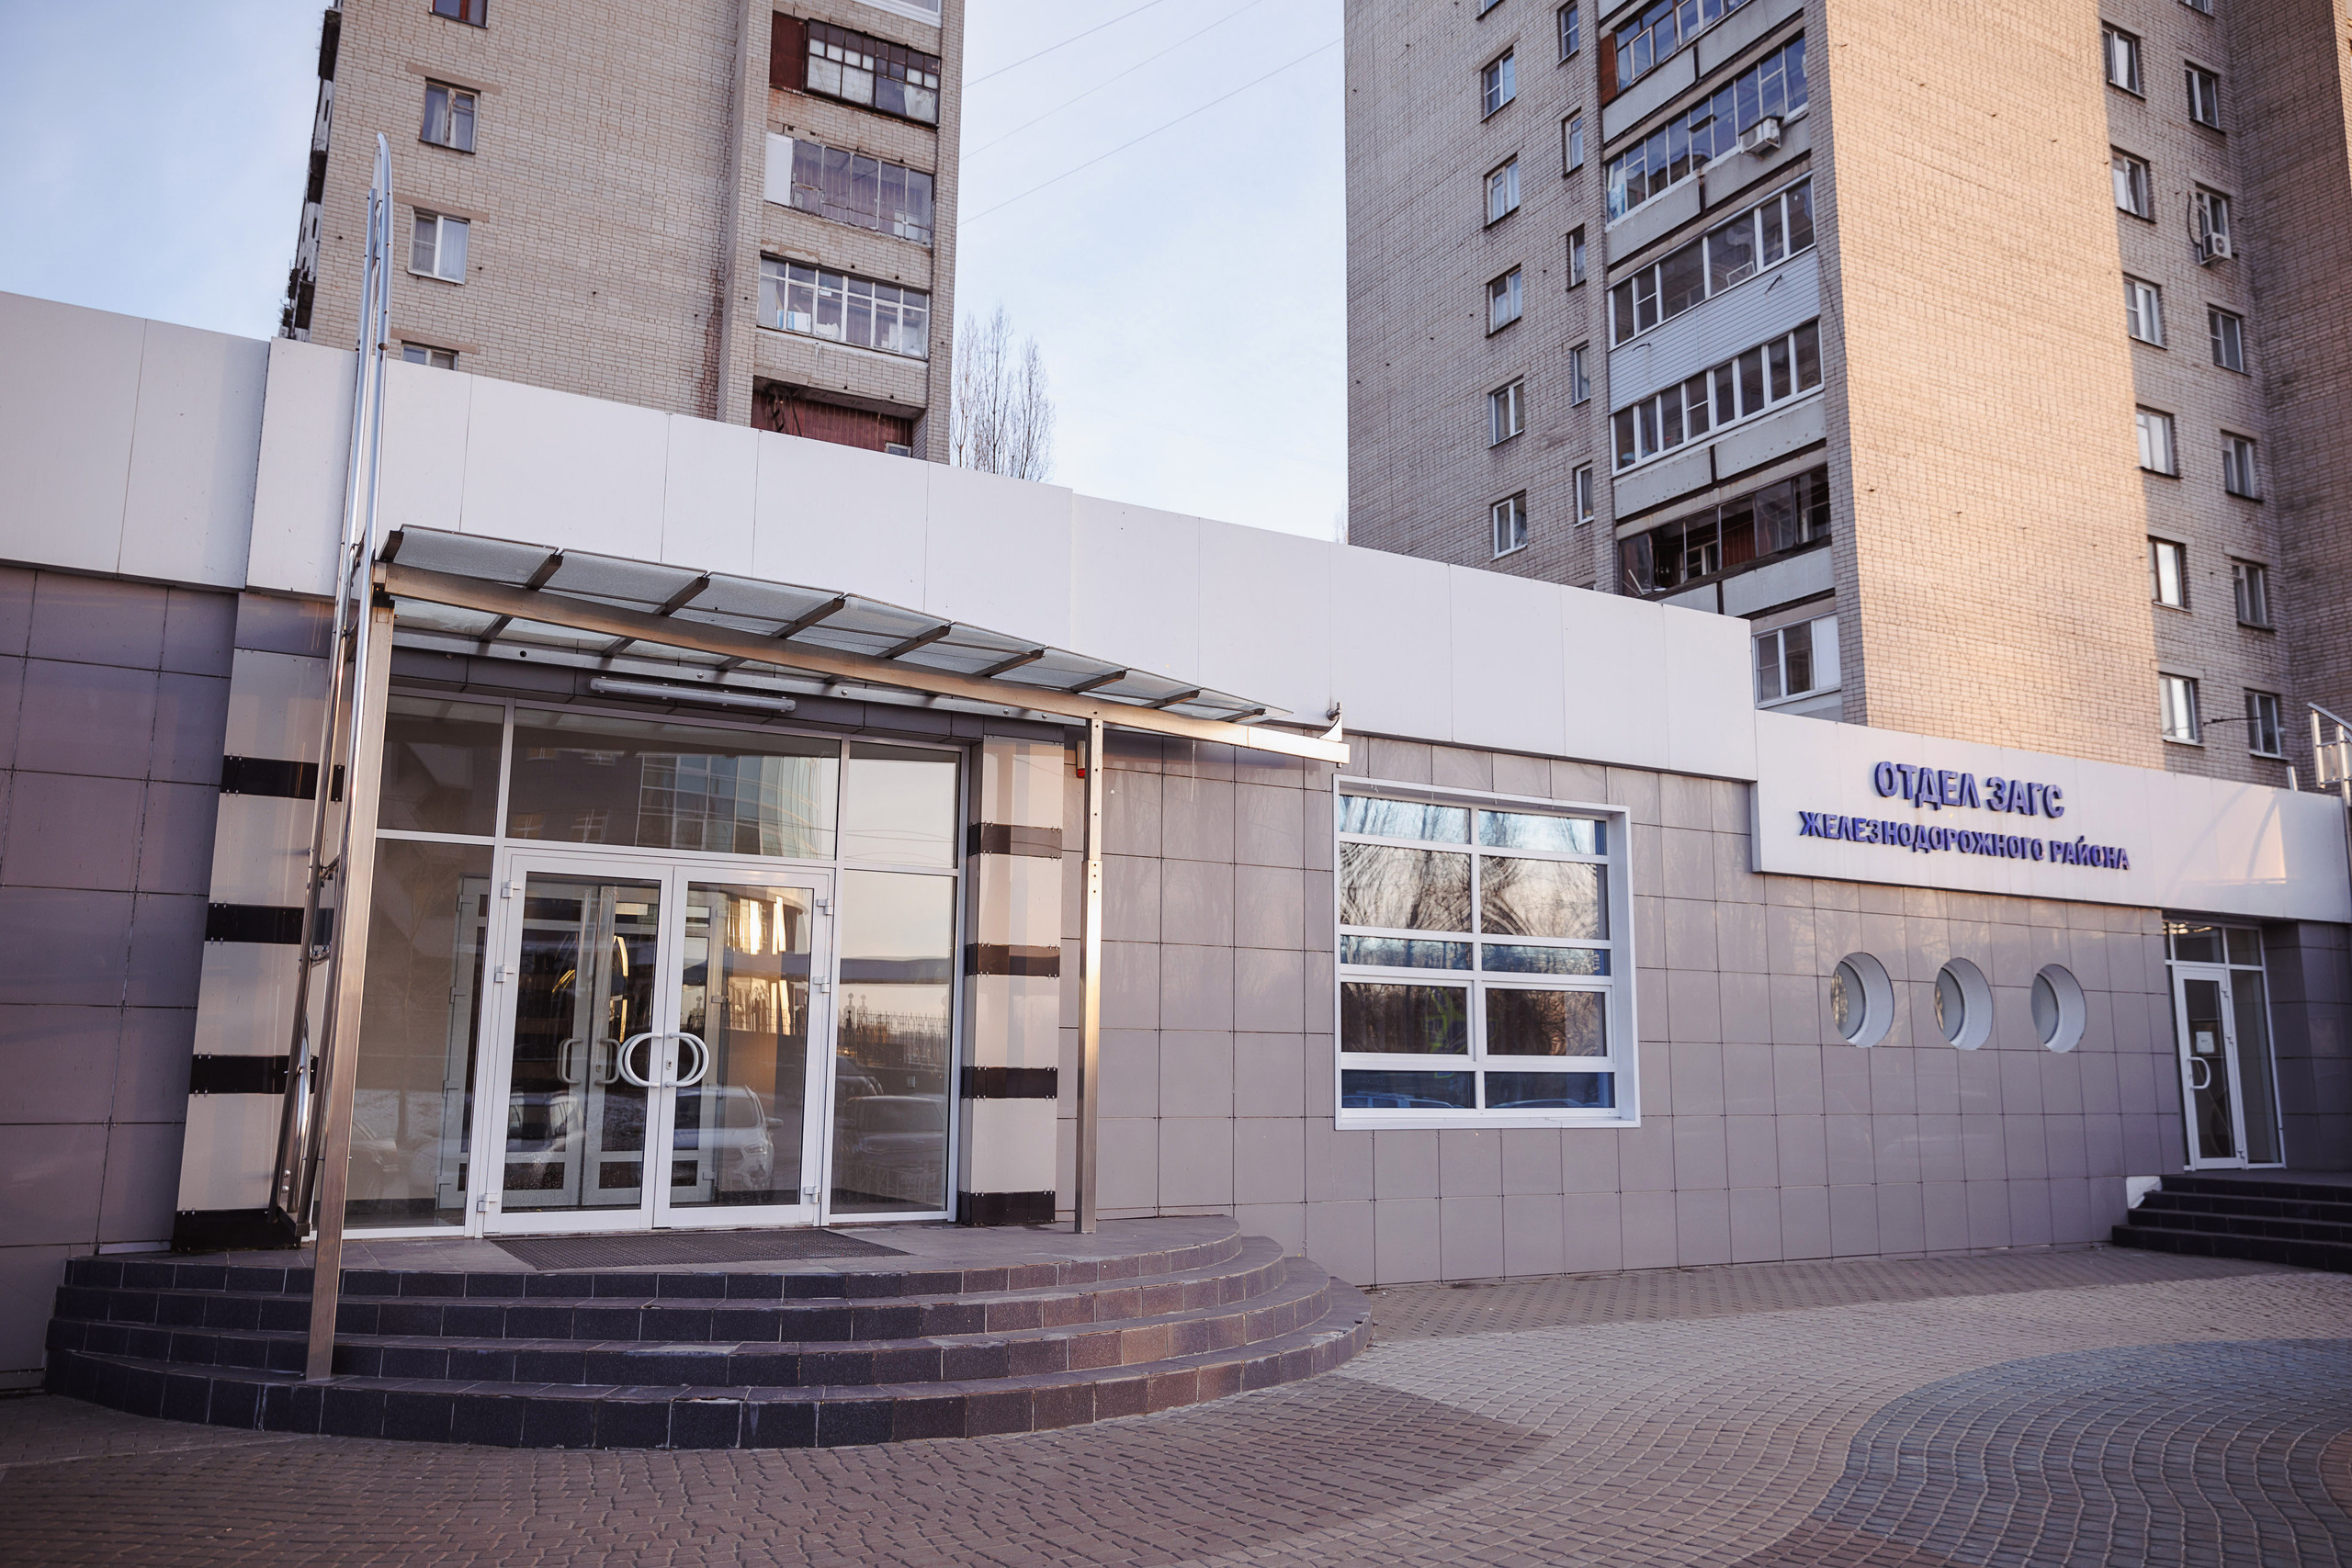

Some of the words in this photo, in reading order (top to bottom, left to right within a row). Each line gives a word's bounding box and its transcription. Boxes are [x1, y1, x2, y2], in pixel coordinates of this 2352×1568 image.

[1874, 761, 1982, 810] ОТДЕЛ
[1985, 776, 2065, 818] ЗАГС
[1799, 811, 2045, 861] ЖЕЛЕЗНОДОРОЖНОГО
[2049, 835, 2131, 870] РАЙОНА
